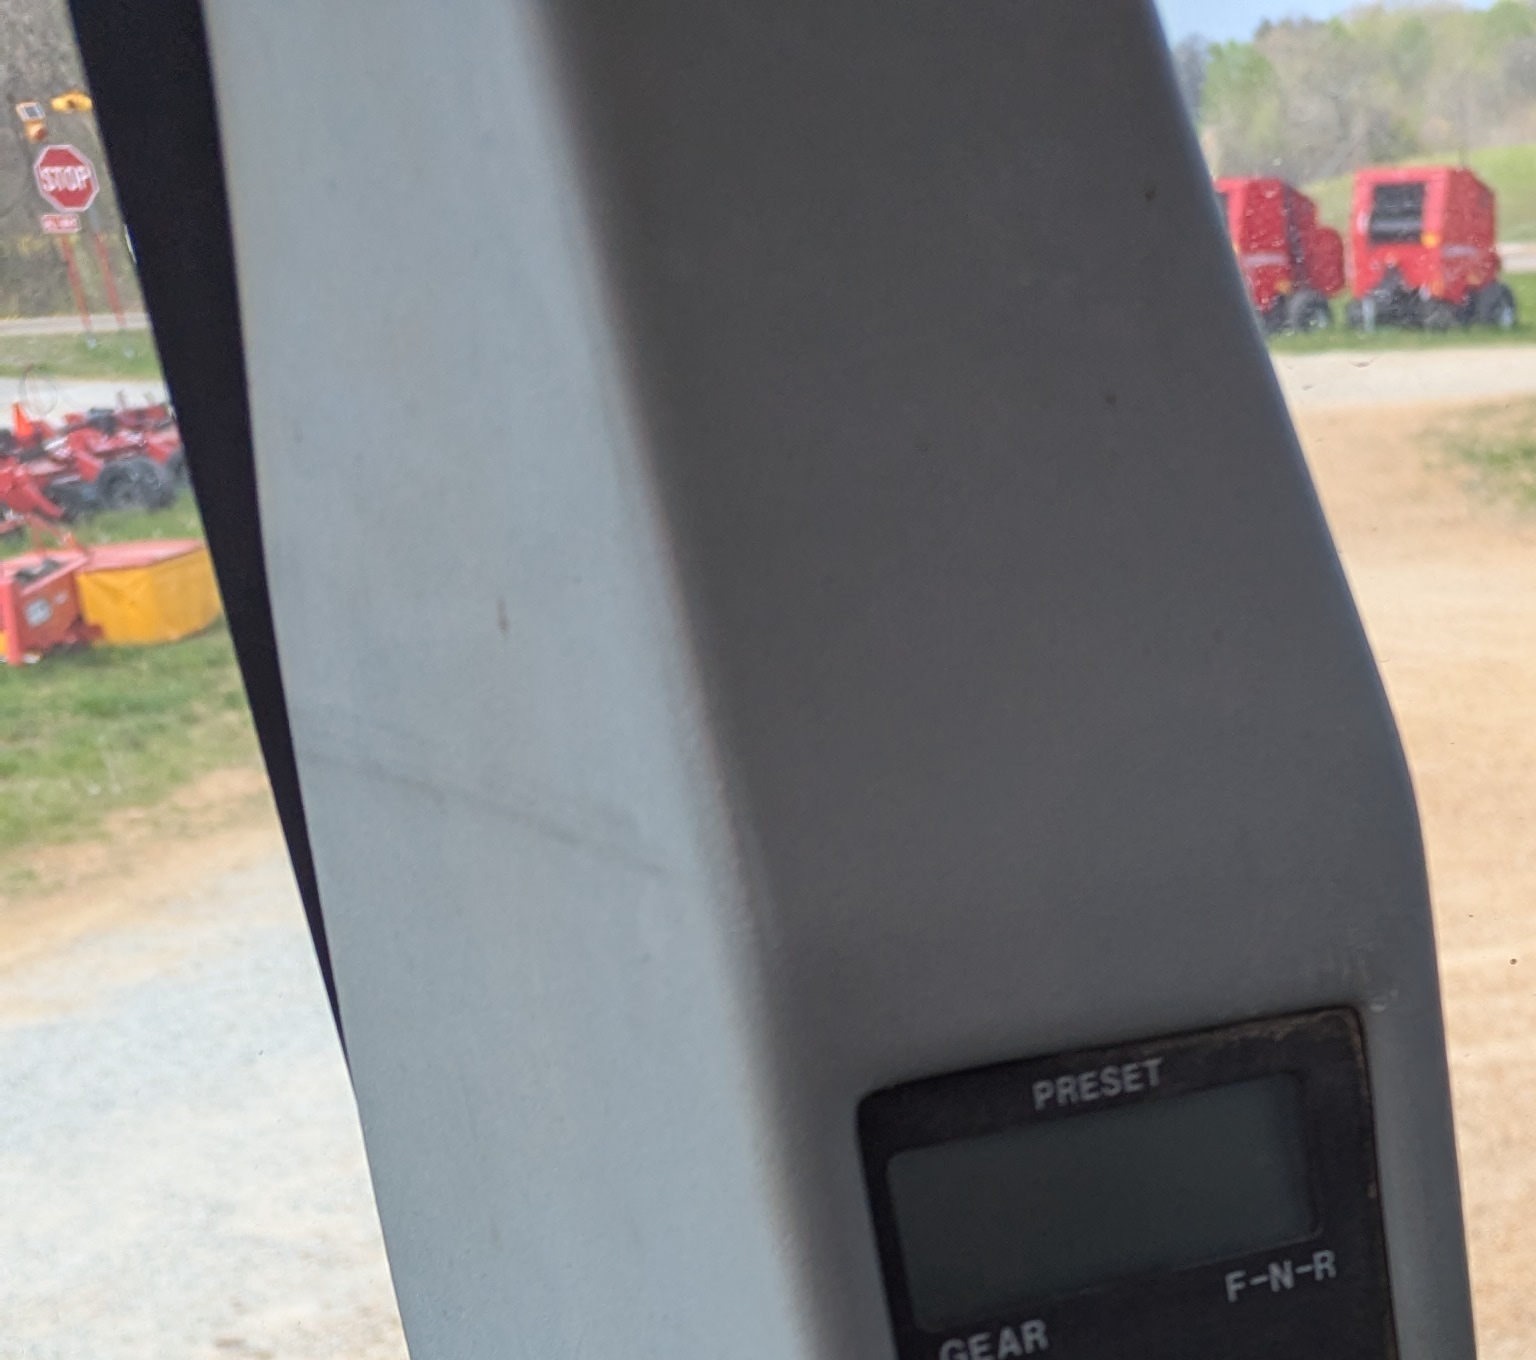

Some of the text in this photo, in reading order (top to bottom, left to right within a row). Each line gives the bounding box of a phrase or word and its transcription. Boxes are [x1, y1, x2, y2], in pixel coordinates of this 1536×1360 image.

[40, 166, 91, 192] STOP
[1032, 1057, 1164, 1111] PRESET
[1224, 1249, 1337, 1302] F-N-R
